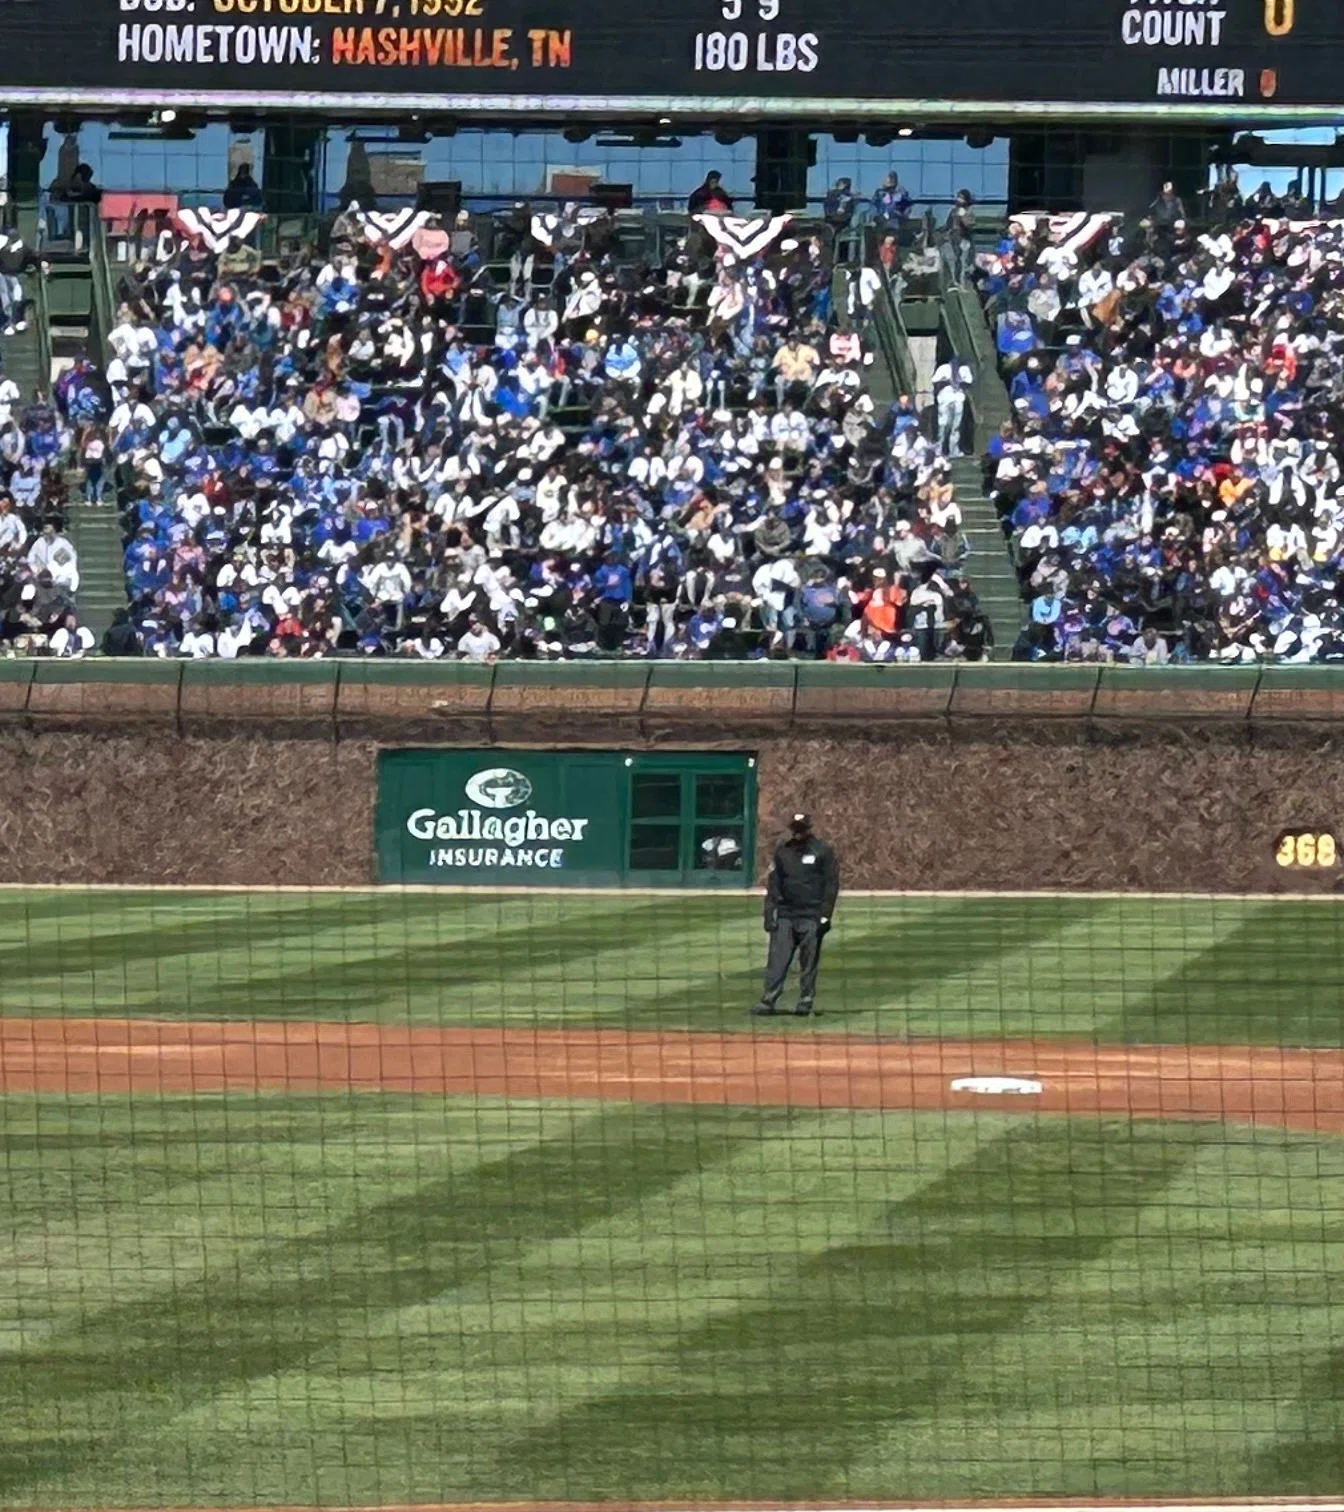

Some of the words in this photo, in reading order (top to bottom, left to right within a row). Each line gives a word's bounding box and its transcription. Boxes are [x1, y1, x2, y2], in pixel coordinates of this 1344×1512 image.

[1121, 9, 1227, 46] COUNT
[118, 23, 319, 65] HOMETOWN:
[332, 26, 518, 71] NASHVILLE,
[527, 28, 572, 68] TN
[694, 31, 749, 72] 180
[756, 32, 820, 72] LBS
[1156, 67, 1245, 97] MILLER
[406, 807, 589, 847] Gallagher
[429, 847, 564, 868] INSURANCE
[1275, 832, 1337, 867] 368
